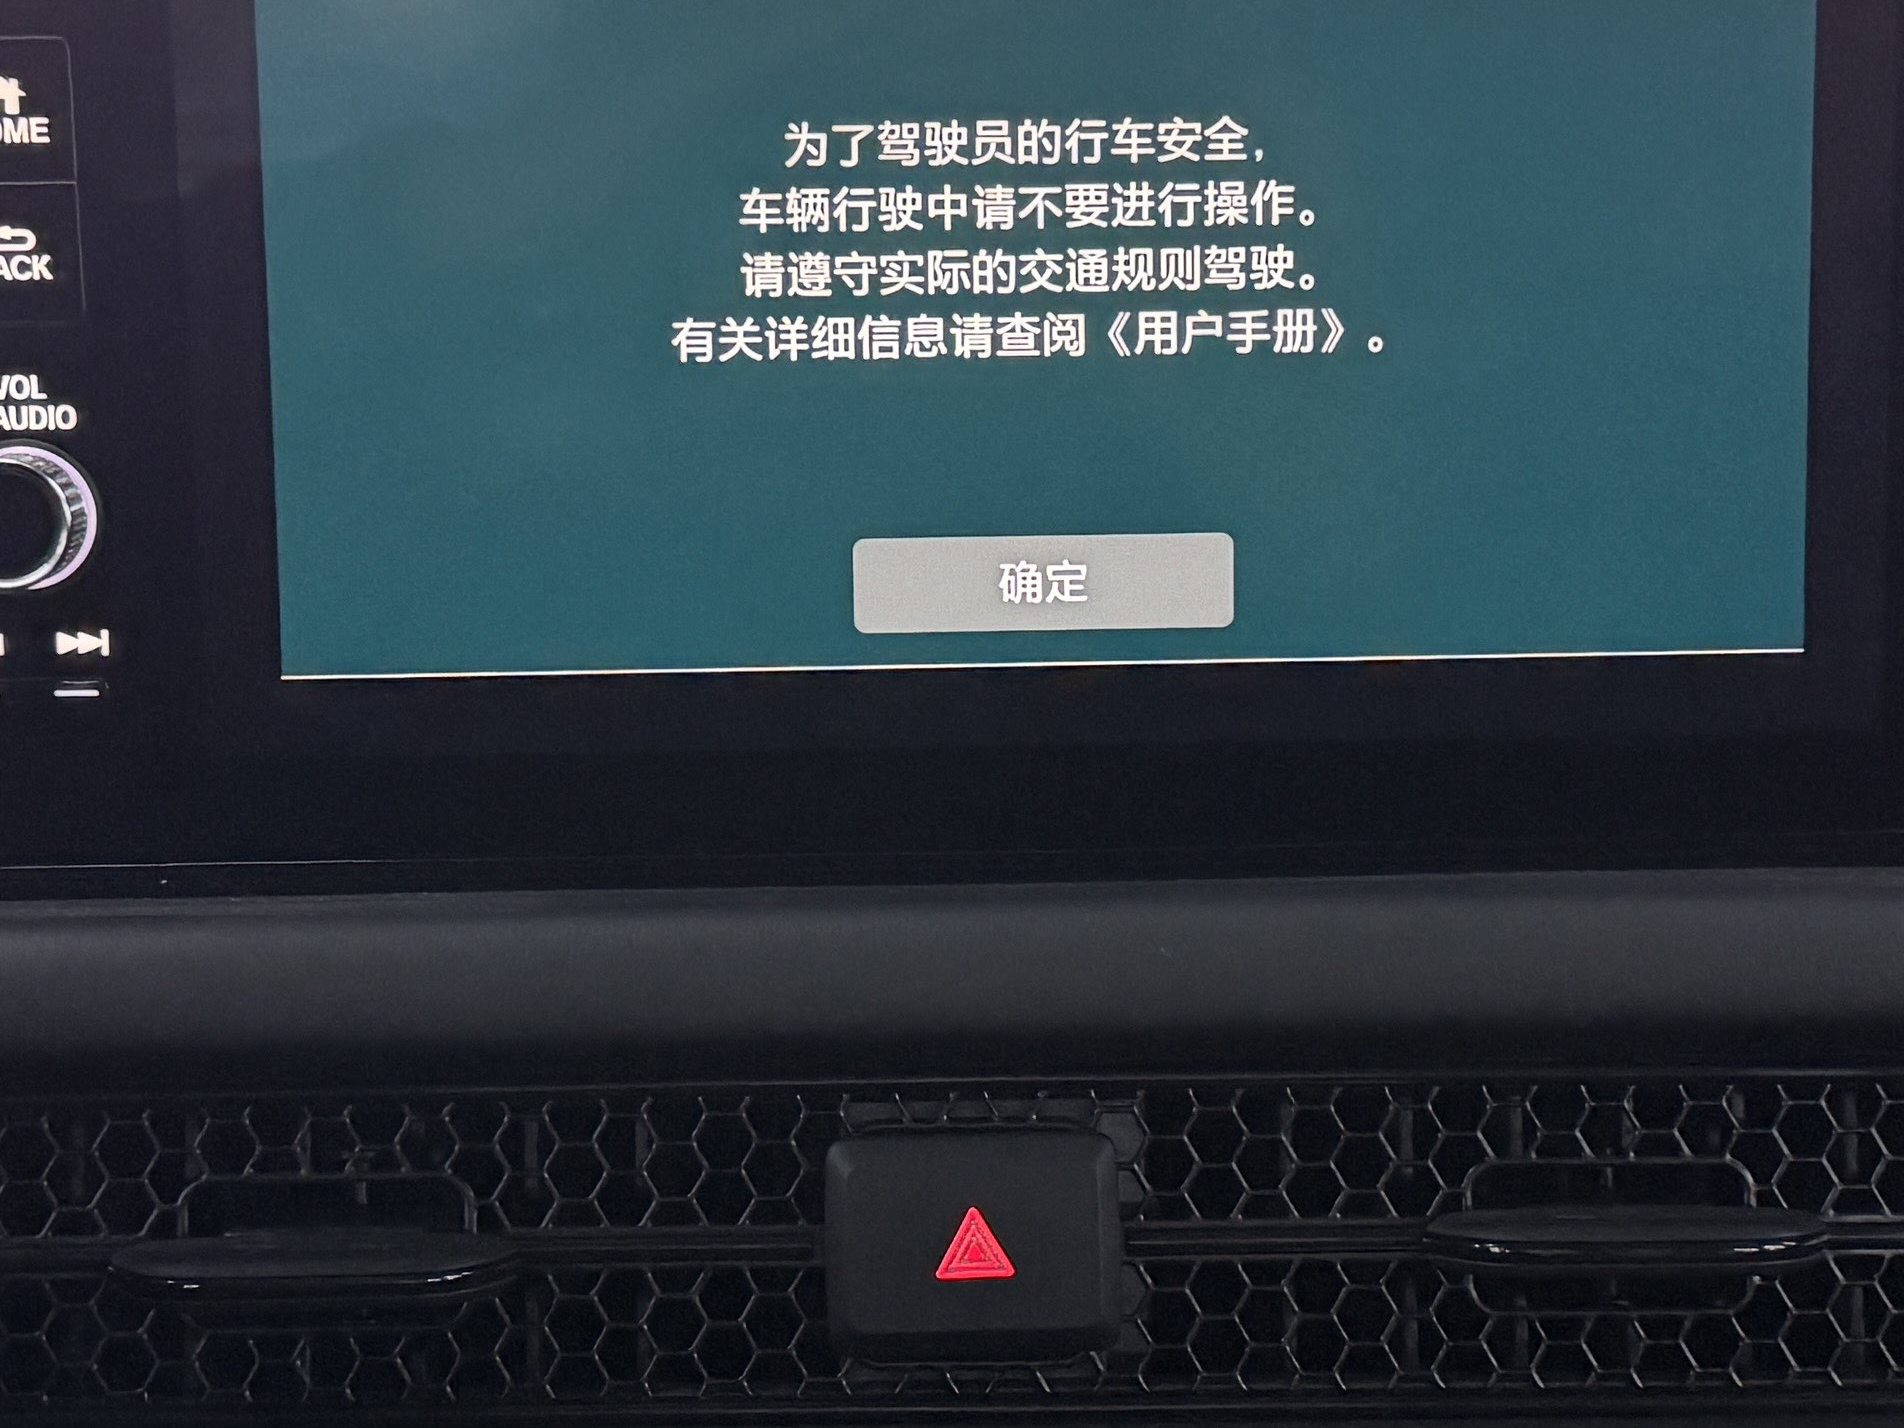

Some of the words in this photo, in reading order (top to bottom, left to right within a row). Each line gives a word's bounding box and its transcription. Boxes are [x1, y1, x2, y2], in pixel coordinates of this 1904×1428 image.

[738, 179, 1315, 234] 车辆行驶中请不要进行操作。
[739, 243, 1315, 299] 请遵守实际的交通规则驾驶。
[671, 307, 1384, 363] 有关详细信息请查阅《用户手册》。
[998, 558, 1089, 604] 确定
